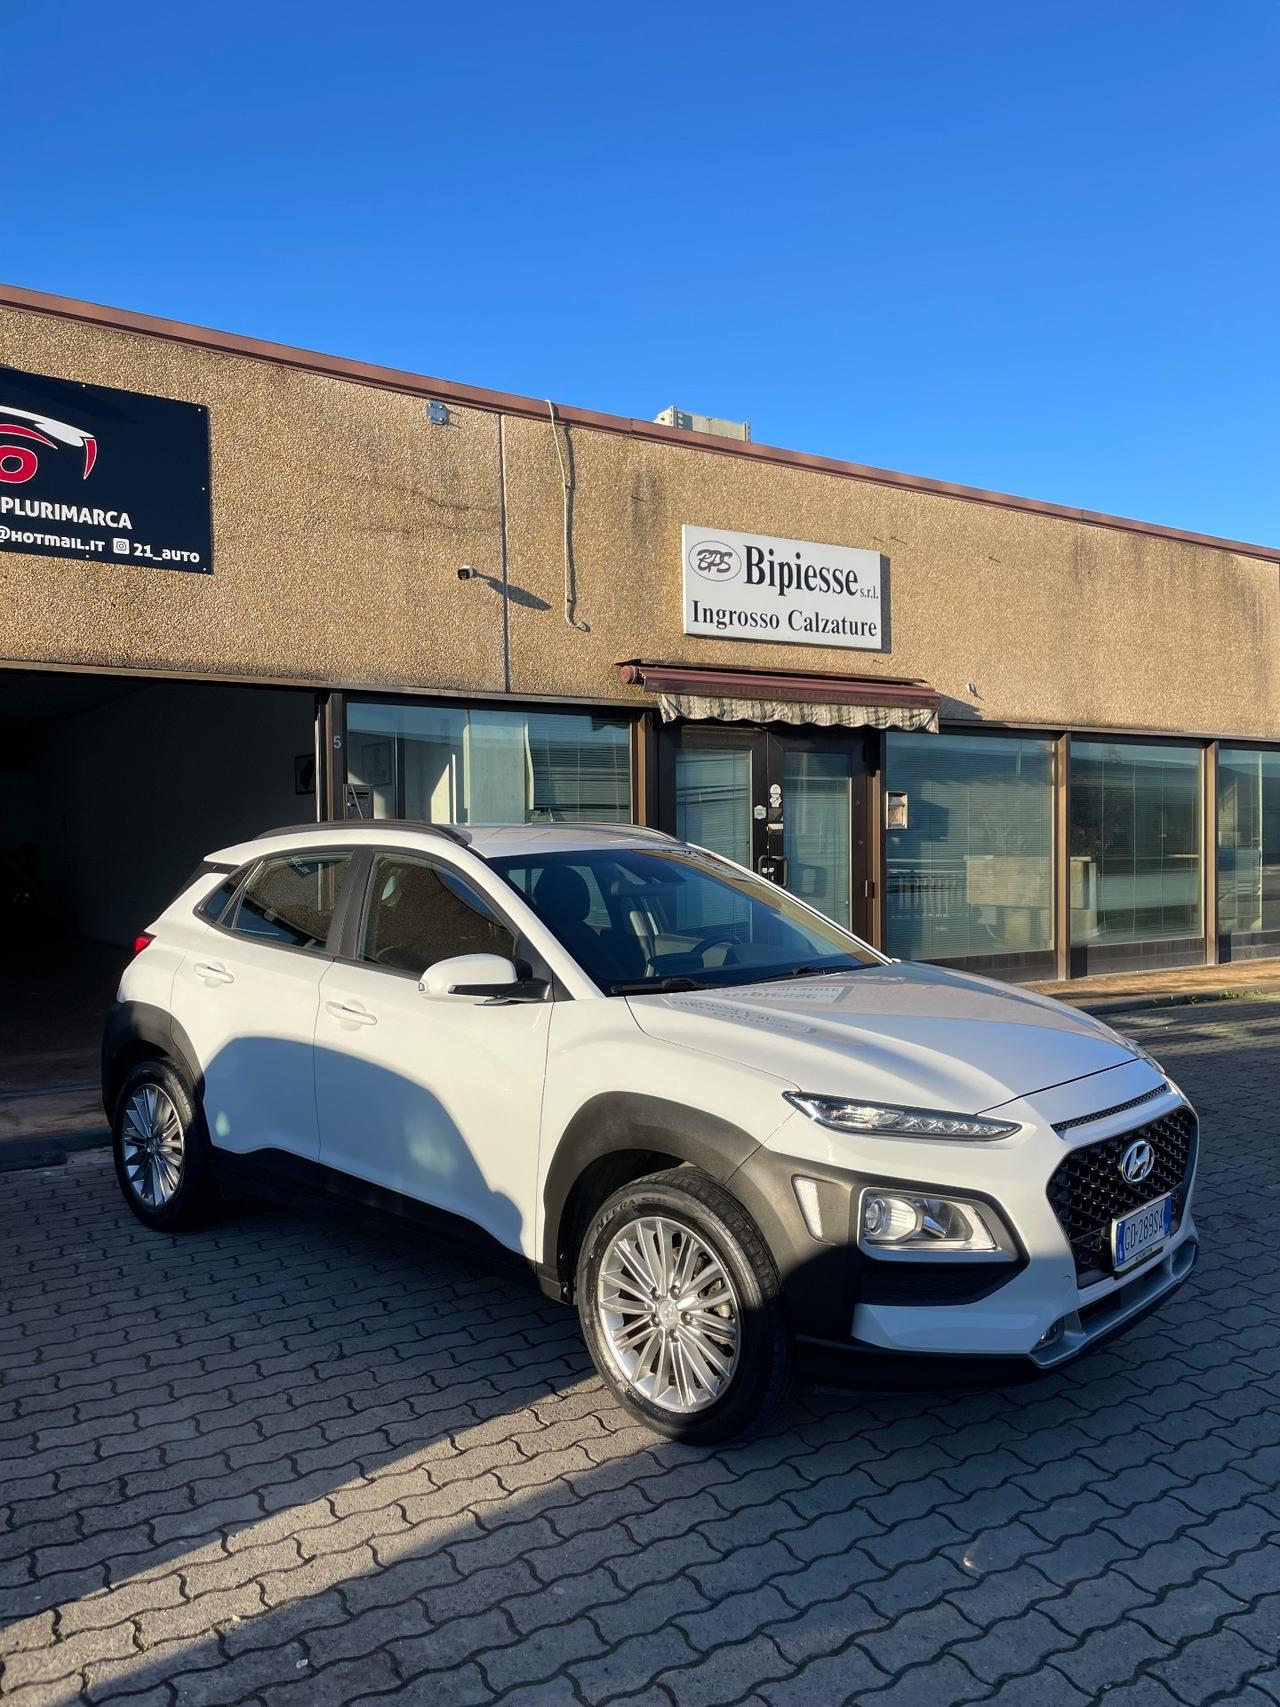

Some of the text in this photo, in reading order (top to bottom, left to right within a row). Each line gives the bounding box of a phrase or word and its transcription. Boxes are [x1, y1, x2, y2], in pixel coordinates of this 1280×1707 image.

[0, 497, 133, 529] PLURIMARCA
[743, 545, 858, 597] Bipiesse
[692, 600, 877, 637] Ingrosso Calzature
[333, 735, 342, 749] 5
